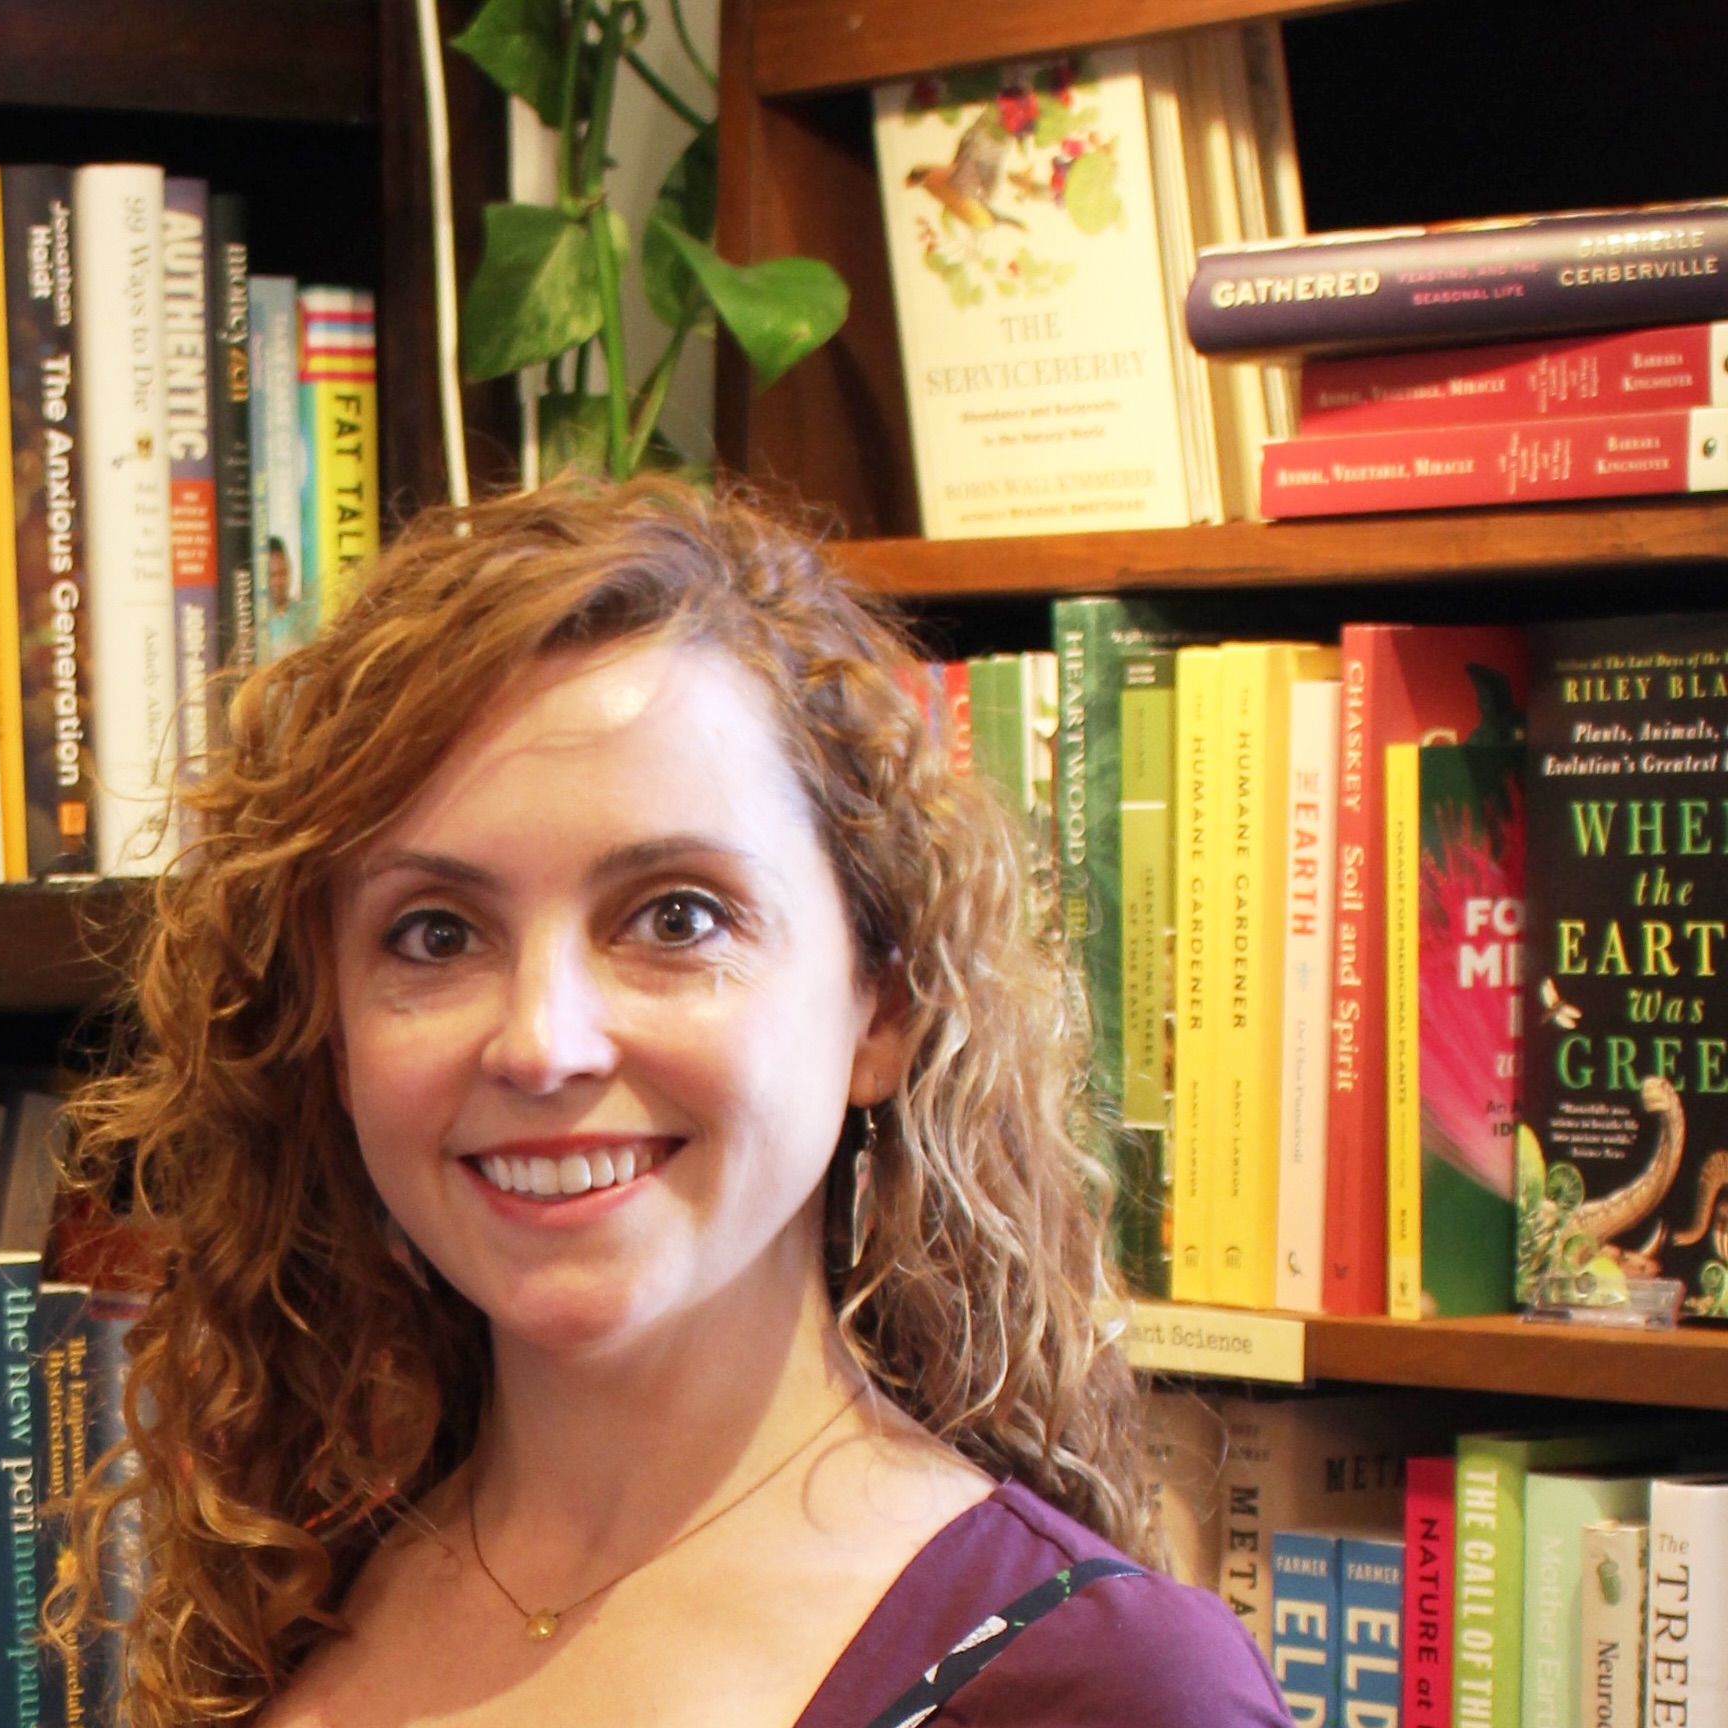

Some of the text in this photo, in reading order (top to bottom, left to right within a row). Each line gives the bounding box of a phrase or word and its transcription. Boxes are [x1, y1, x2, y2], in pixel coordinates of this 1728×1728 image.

[27, 224, 53, 300] Haidt
[1210, 270, 1381, 310] GATHERED
[1559, 256, 1719, 288] CERBERVILLE
[162, 210, 208, 462] AUTHENTIC
[1000, 312, 1063, 345] THE
[927, 350, 1147, 397] SERVICEBERRY
[335, 391, 363, 457] FAT
[40, 353, 83, 787] The Anxious Generation
[1562, 674, 1652, 704] RILEY
[1062, 629, 1089, 866] HEARTWOOD
[1189, 736, 1206, 1031] HUMANE GARDENER
[1232, 731, 1253, 1030] HUMANE GARDENER
[1290, 802, 1319, 937] EARTH
[1332, 660, 1365, 1092] CHASKEY Soil and Spirit
[1634, 867, 1694, 907] the
[1628, 989, 1705, 1026] Was
[4, 1287, 37, 1446] the new
[1462, 1468, 1499, 1531] THE
[1416, 1517, 1441, 1664] NATURE
[1461, 1540, 1497, 1618] CALL
[1537, 1536, 1564, 1646] Mother
[1460, 1628, 1494, 1673] OF
[1652, 1562, 1691, 1728] TREE
[1416, 1677, 1435, 1712] at
